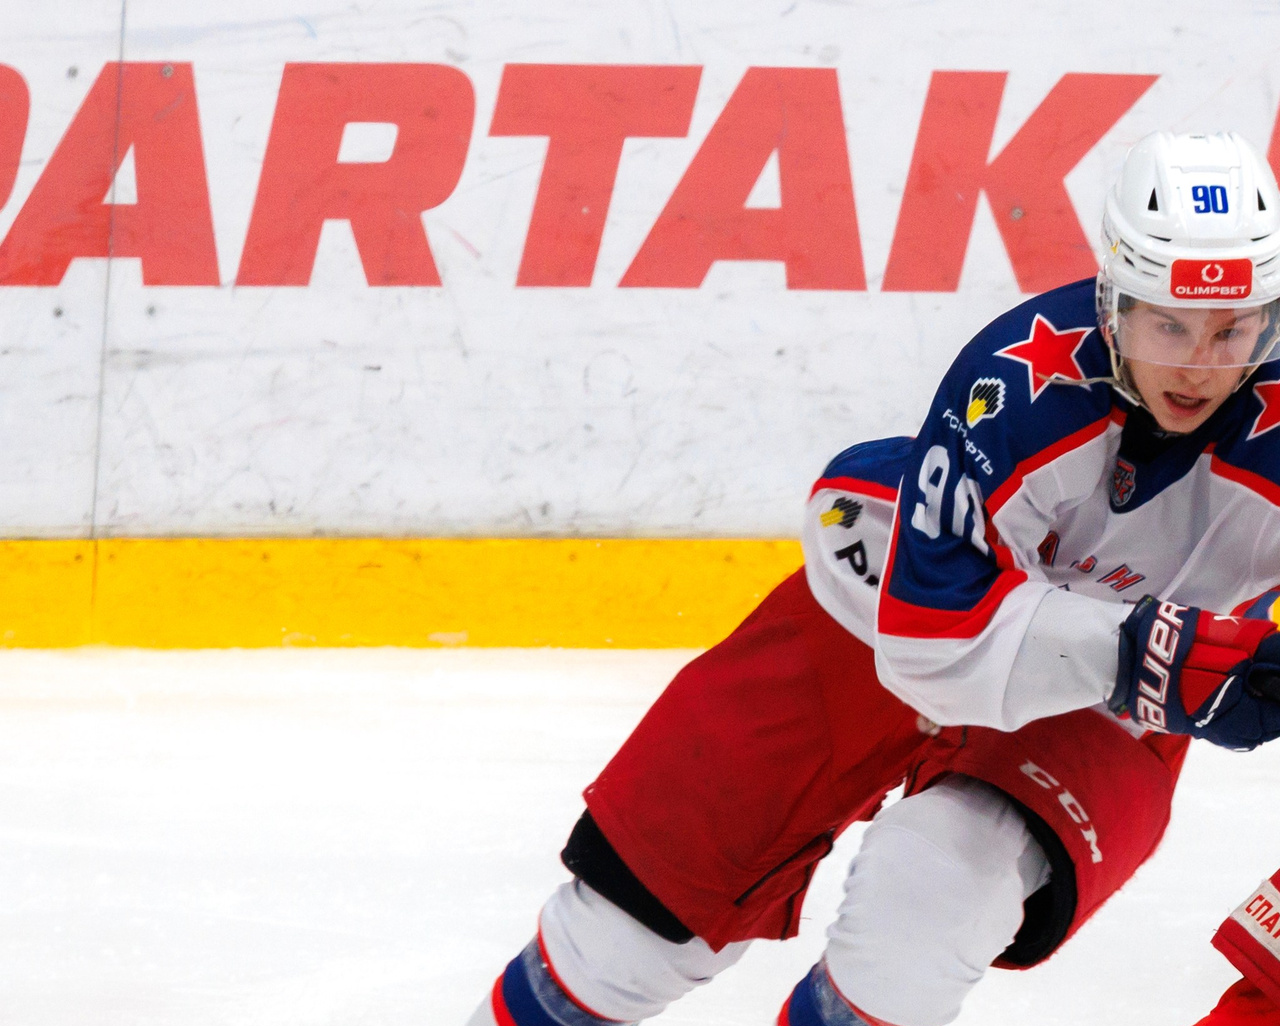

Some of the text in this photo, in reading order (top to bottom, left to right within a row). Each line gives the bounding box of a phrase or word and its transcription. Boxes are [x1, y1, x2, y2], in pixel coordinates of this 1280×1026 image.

[0, 60, 1160, 293] ARTAK
[1192, 185, 1229, 214] 90
[1175, 285, 1248, 296] OLIMPBET
[1019, 758, 1104, 865] CCM
